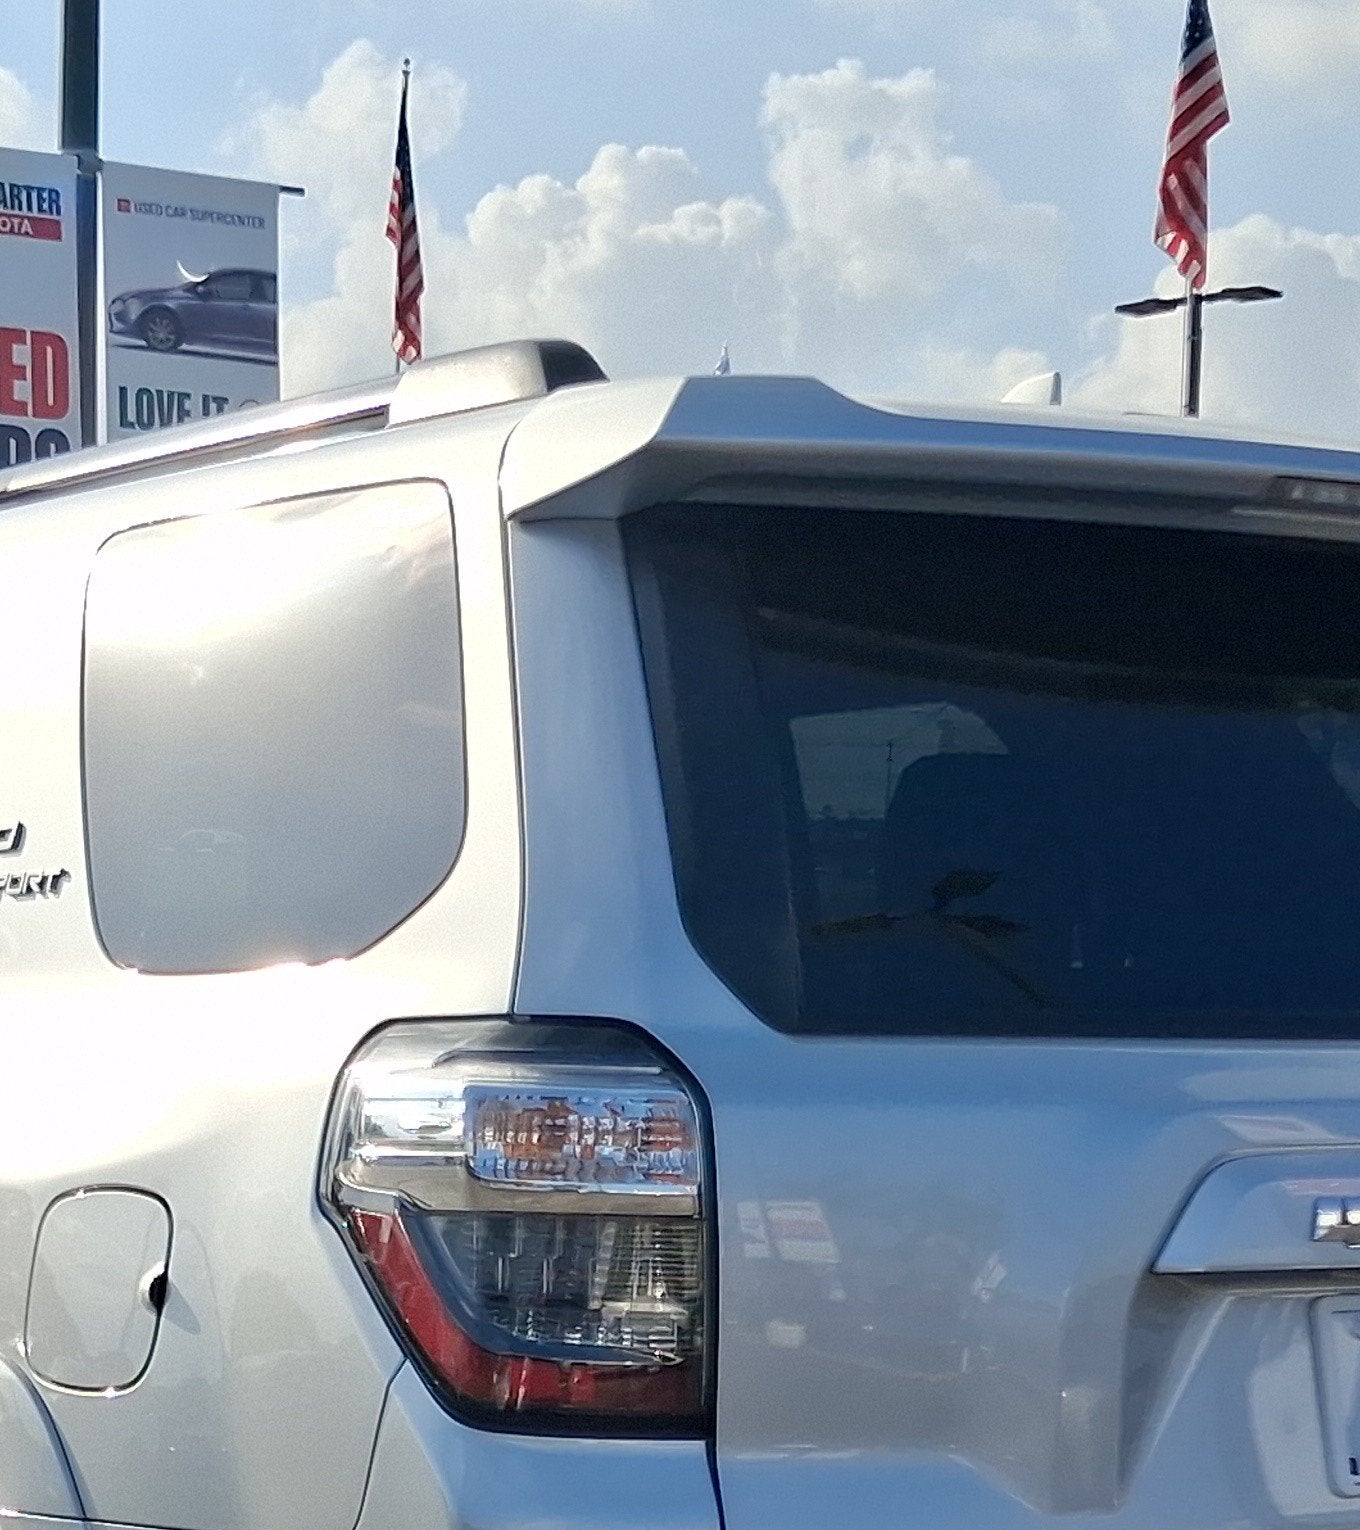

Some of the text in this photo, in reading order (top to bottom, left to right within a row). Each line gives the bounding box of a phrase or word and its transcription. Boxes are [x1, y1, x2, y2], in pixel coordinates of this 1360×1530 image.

[134, 202, 163, 216] USED
[165, 205, 187, 218] CAR
[118, 385, 192, 431] LOVE
